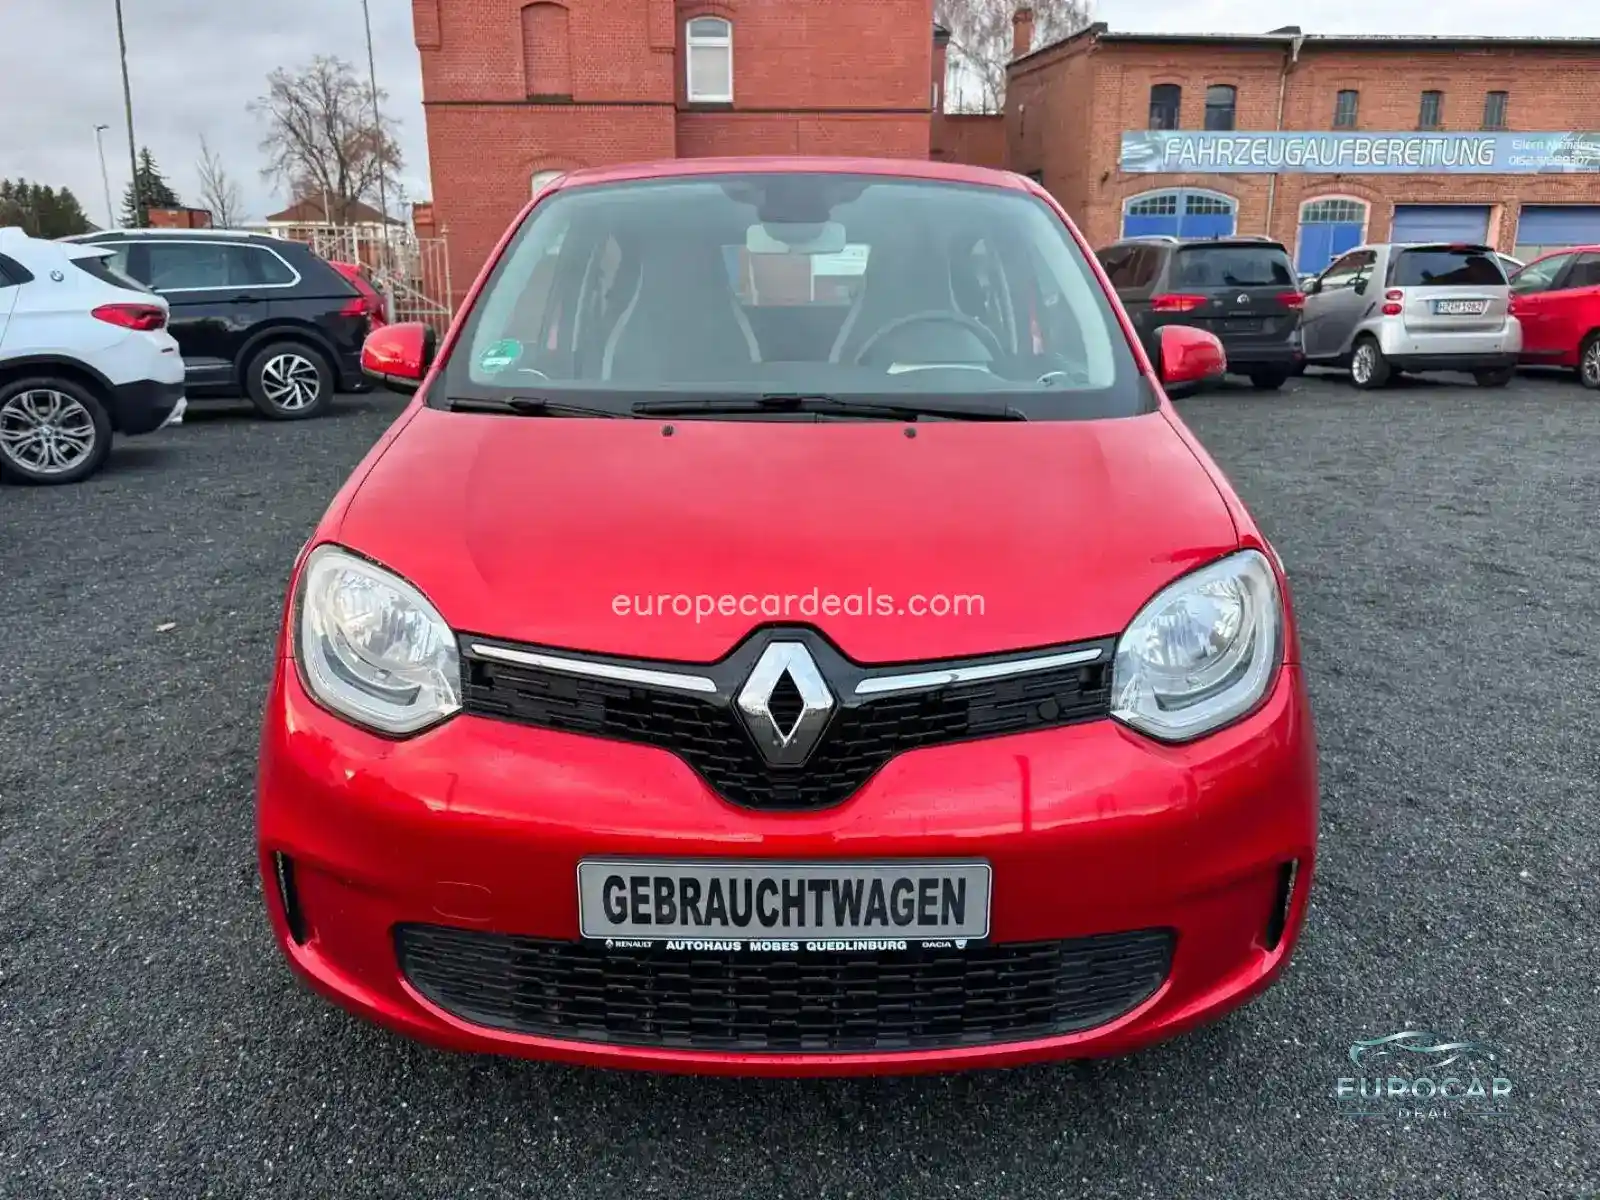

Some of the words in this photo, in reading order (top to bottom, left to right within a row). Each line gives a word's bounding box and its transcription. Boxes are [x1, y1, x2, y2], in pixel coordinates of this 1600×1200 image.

[1163, 136, 1496, 167] FAHRZEUGAUFBEREITUNG
[602, 875, 967, 928] GEBRAUCHTWAGEN
[615, 940, 653, 949] RENAULT
[665, 940, 742, 952] AUTOHAUS
[806, 940, 907, 952] QUEDLINBURG
[922, 941, 951, 949] DACIA
